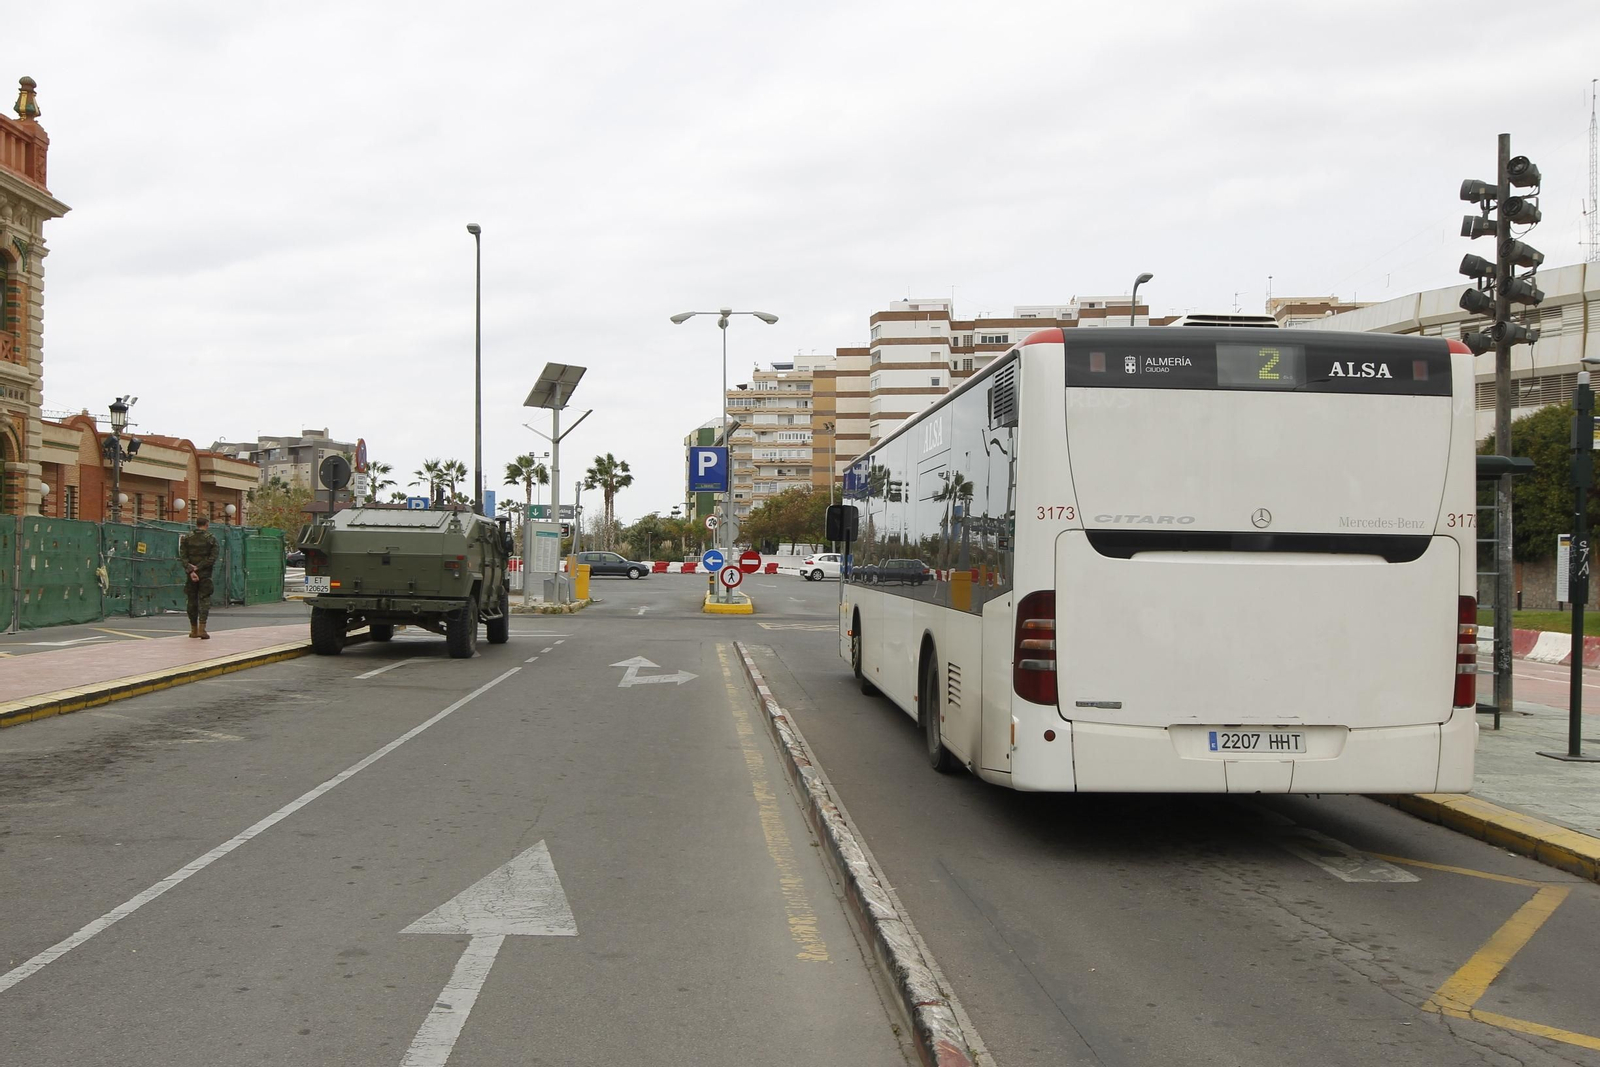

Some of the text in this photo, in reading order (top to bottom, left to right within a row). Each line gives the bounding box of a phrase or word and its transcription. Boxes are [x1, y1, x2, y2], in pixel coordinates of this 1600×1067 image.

[1145, 356, 1192, 367] ALMERÍA
[1258, 348, 1279, 379] 2
[1328, 361, 1393, 379] ALSA
[923, 416, 943, 454] ALSA
[698, 451, 718, 477] P
[1036, 506, 1075, 520] 3173
[1094, 514, 1196, 525] CITARO
[1338, 516, 1425, 529] Mercedes-Benz
[305, 585, 329, 593] 120625
[1221, 733, 1301, 750] 2207 HHT
